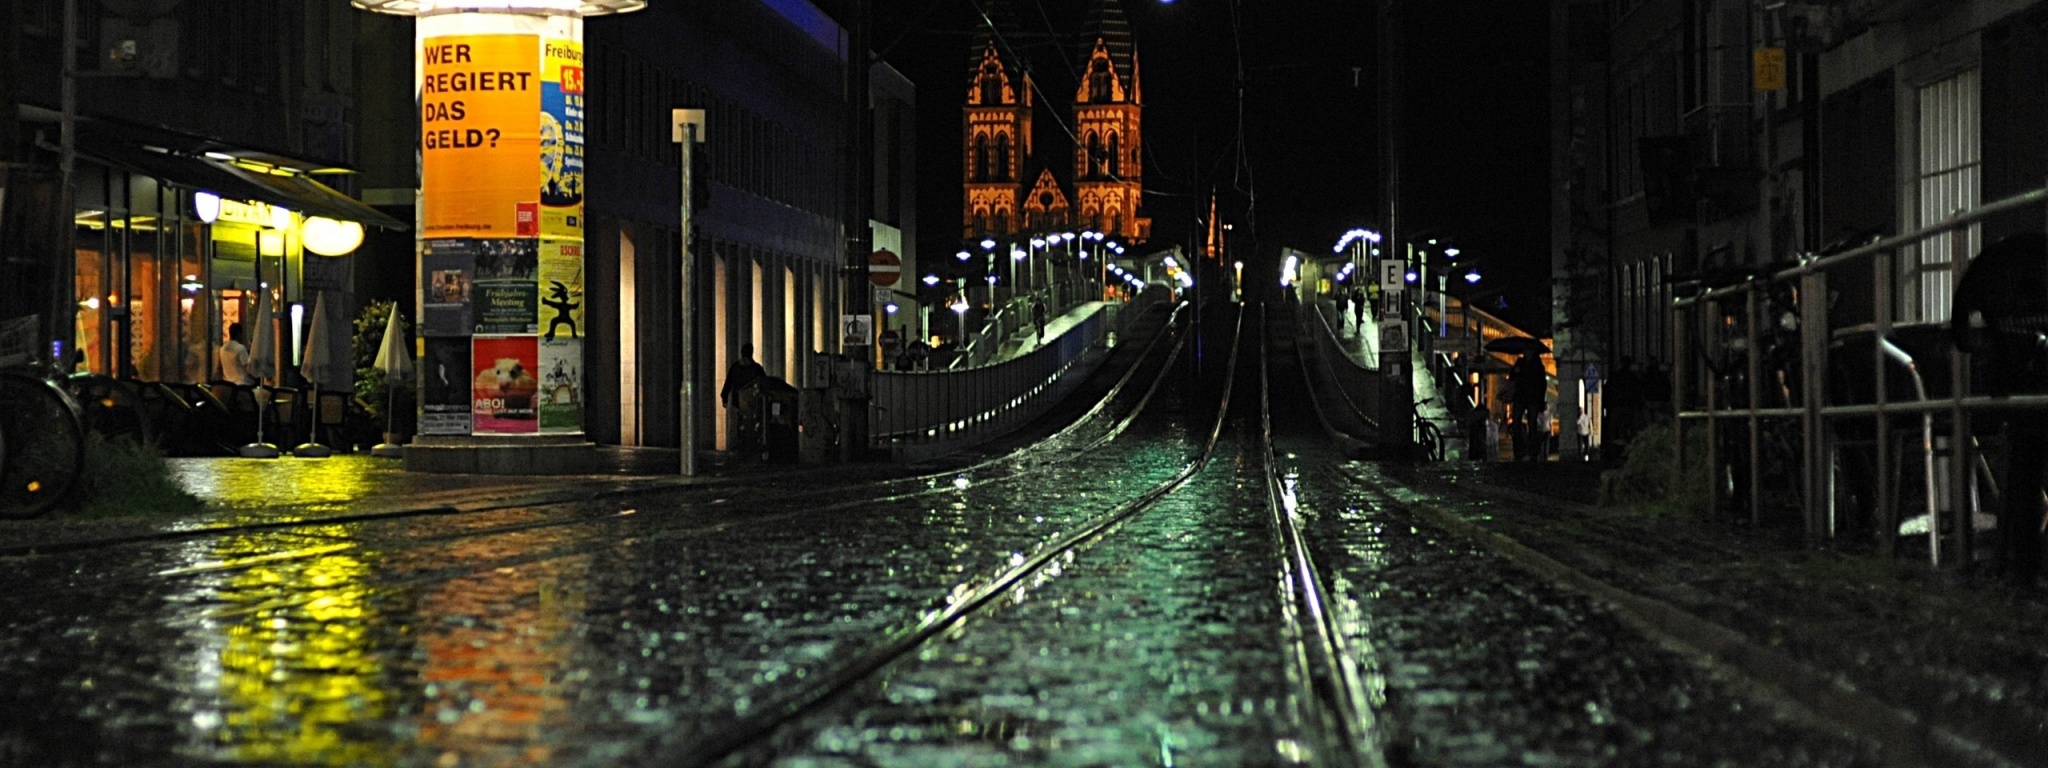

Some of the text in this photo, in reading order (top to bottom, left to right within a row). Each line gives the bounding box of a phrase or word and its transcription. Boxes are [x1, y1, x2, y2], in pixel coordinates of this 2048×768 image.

[425, 44, 471, 65] WER
[425, 71, 531, 94] REGIERT
[425, 100, 465, 122] DAS
[425, 128, 500, 150] GELD?
[1388, 265, 1396, 284] E
[491, 298, 525, 308] Meeting
[475, 398, 505, 409] ABO!
